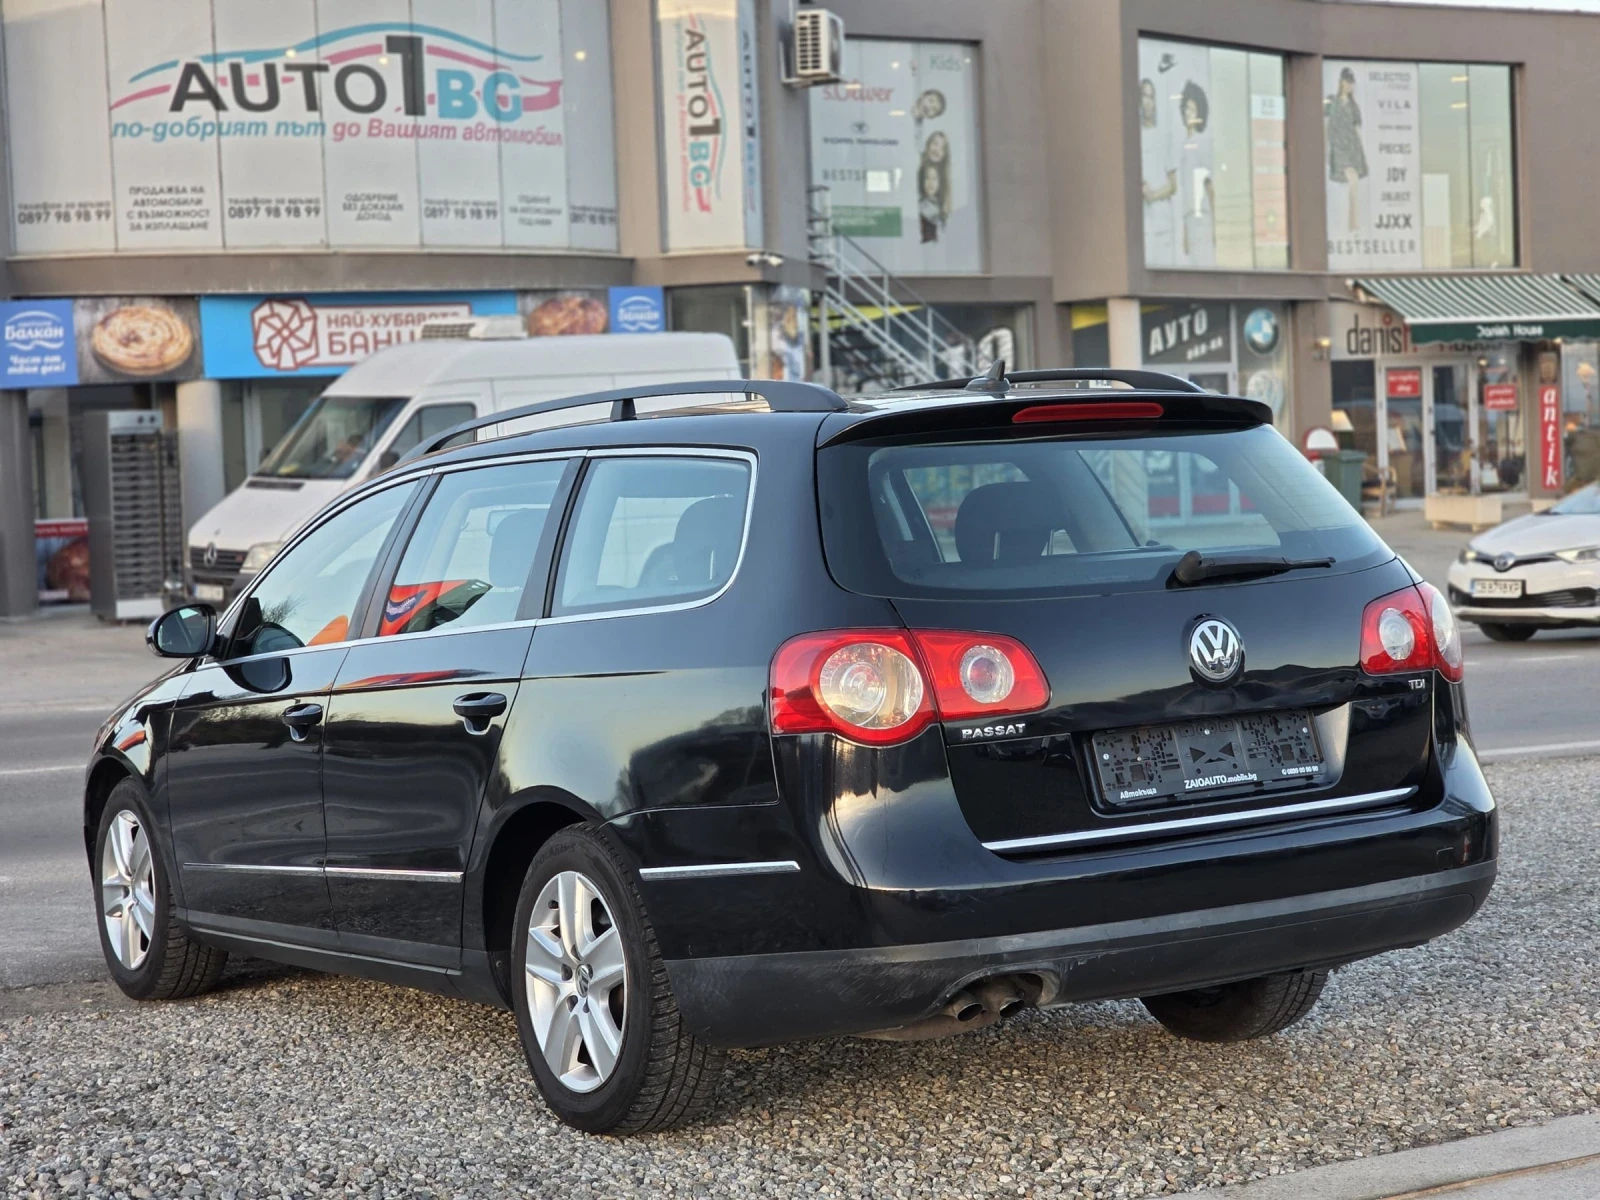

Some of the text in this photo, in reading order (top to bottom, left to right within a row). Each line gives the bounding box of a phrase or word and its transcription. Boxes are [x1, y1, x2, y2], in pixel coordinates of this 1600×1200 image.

[1377, 99, 1412, 109] VILA
[112, 115, 267, 143] по-добрият
[275, 120, 327, 138] път
[333, 121, 361, 142] до
[367, 118, 458, 141] Вашият
[1386, 166, 1407, 183] JDY
[18, 210, 50, 225] 0897
[228, 206, 260, 219] 0897
[1375, 213, 1412, 230] JJXX
[1327, 239, 1417, 255] BESTSELLER
[5, 325, 65, 341] Балкан
[1513, 324, 1544, 336] House
[1543, 388, 1558, 487] antik
[1408, 679, 1425, 690] TDI
[961, 723, 1026, 739] PASSAT
